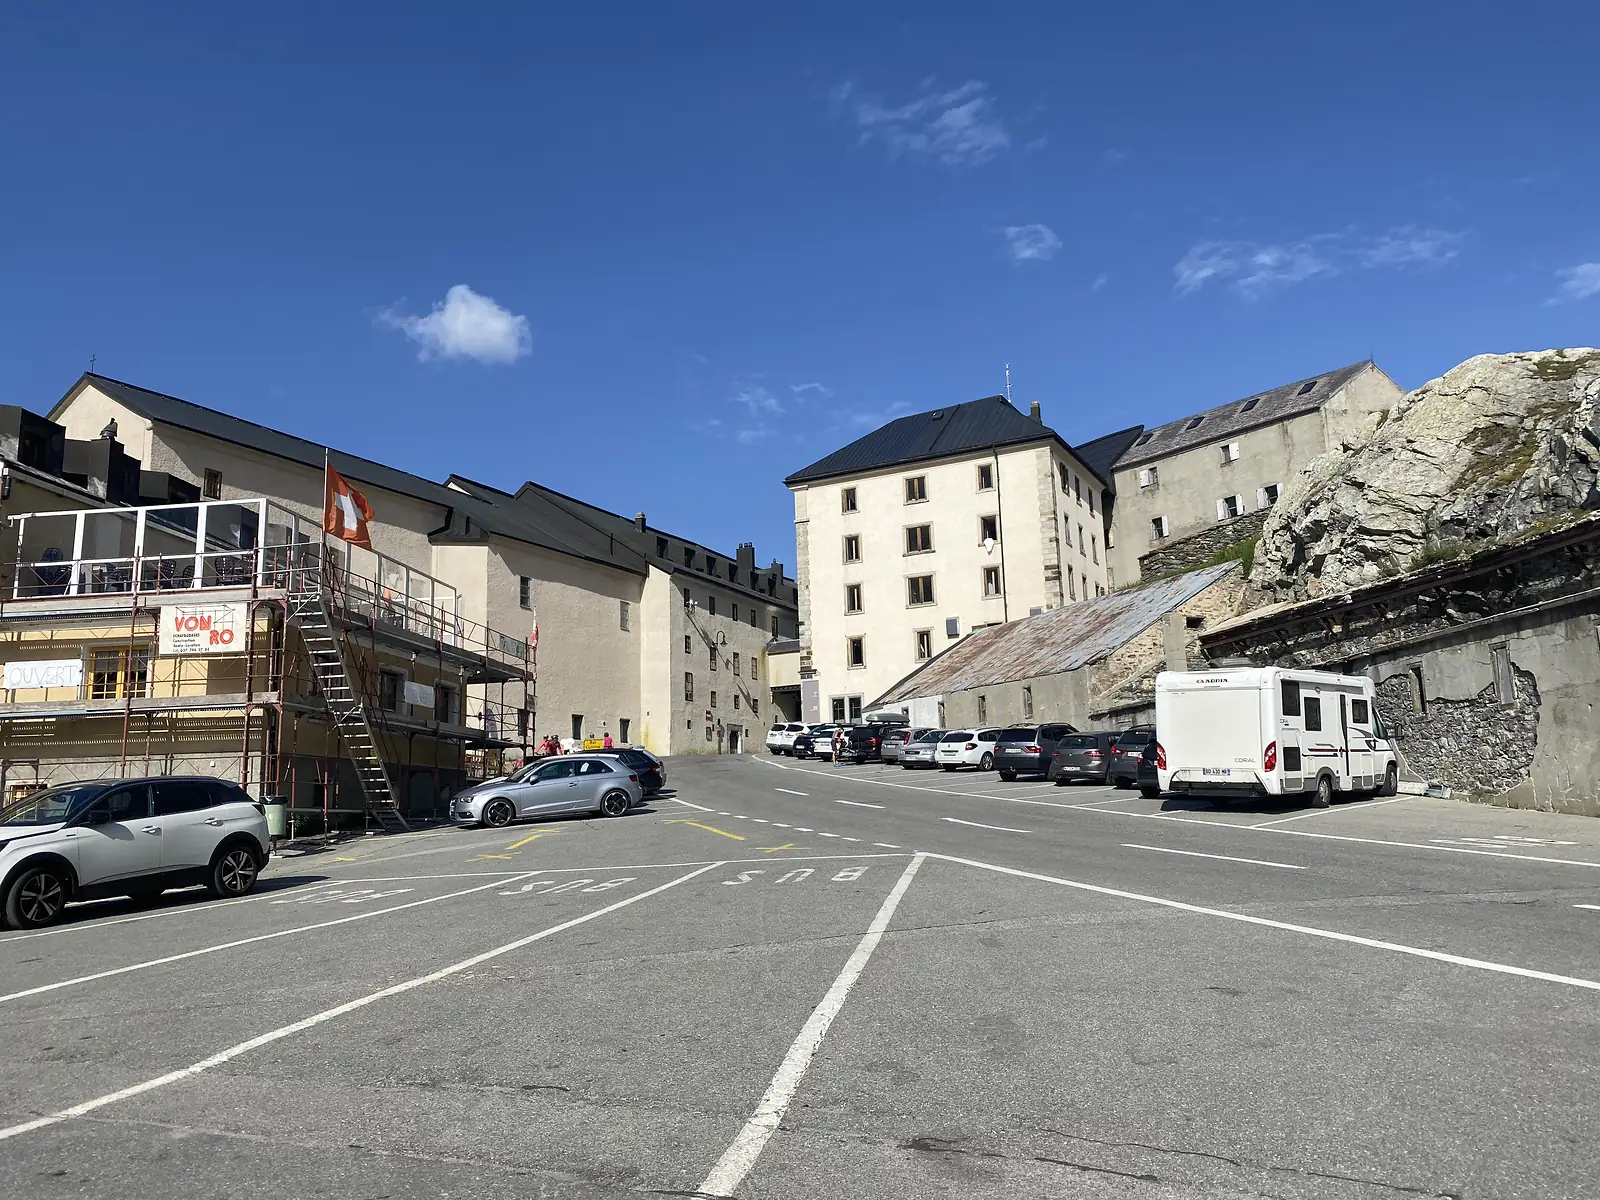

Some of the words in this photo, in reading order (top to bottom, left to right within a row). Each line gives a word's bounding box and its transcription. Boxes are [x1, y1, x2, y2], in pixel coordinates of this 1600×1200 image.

[174, 615, 212, 632] VON
[209, 629, 235, 645] RO
[9, 665, 78, 686] OUVERT
[721, 866, 870, 886] BUS
